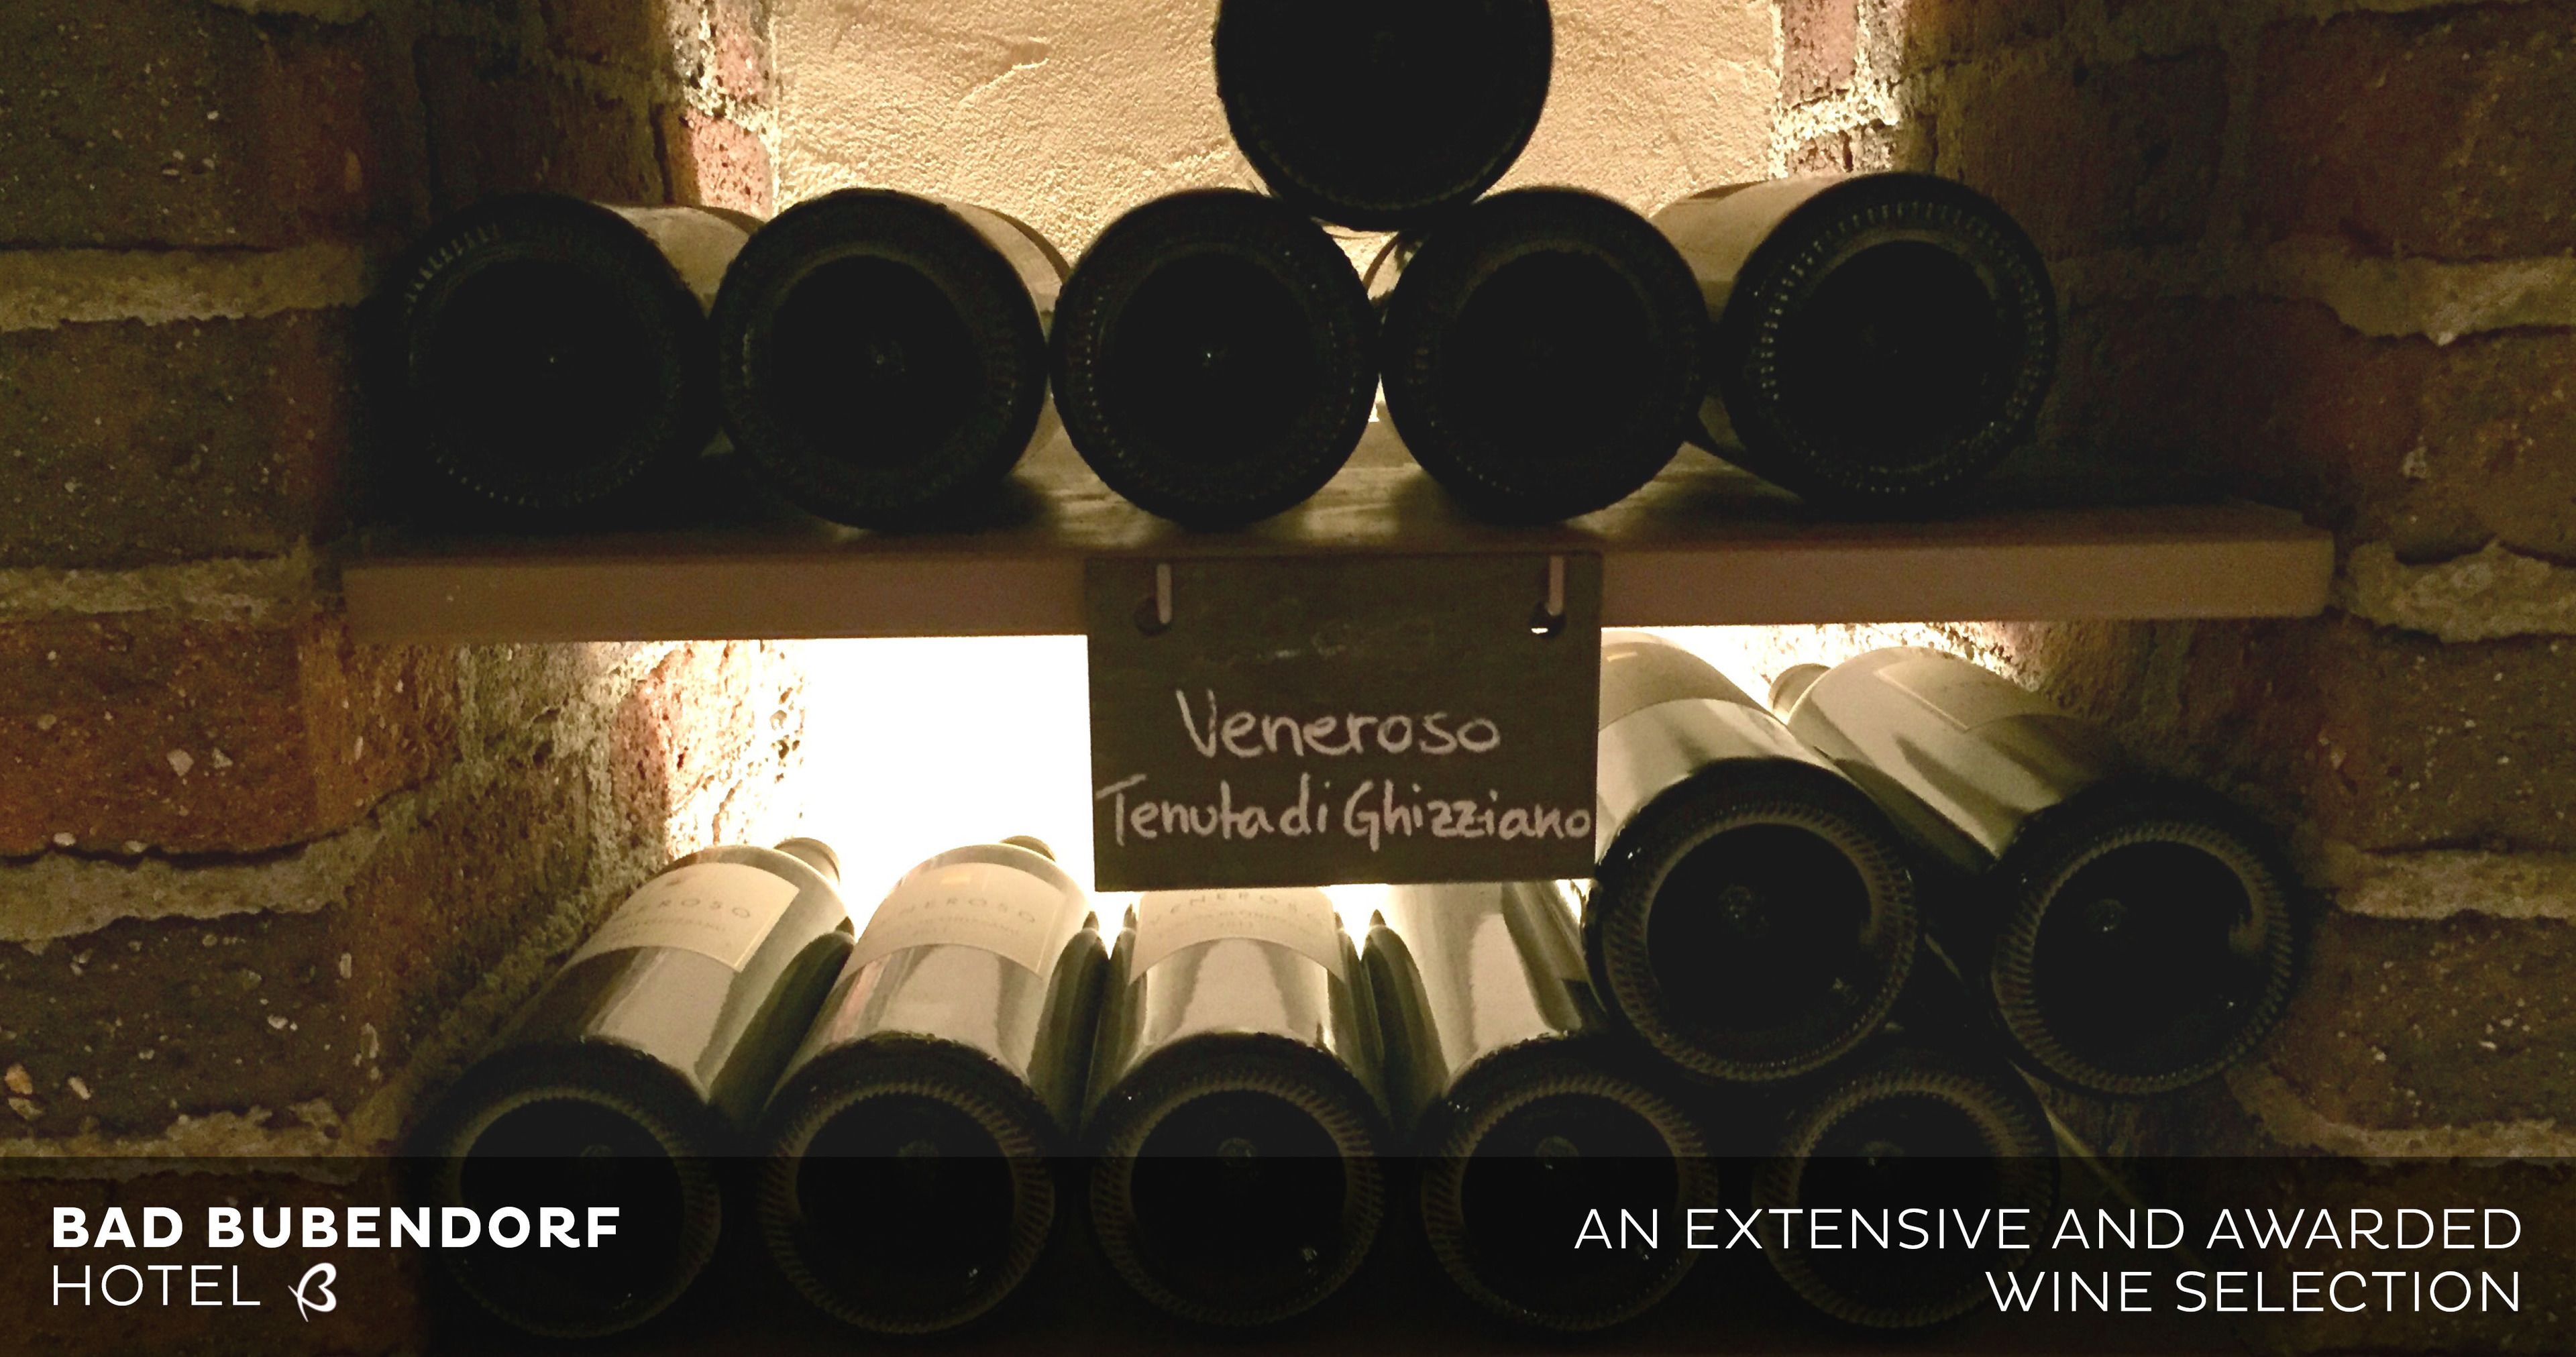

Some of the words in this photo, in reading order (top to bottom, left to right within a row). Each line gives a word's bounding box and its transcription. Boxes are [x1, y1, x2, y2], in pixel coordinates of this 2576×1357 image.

[1175, 689, 1501, 757] Veneroso
[1095, 773, 1275, 847] Tenuta
[1279, 771, 1330, 836] di
[1344, 779, 1591, 853] Ghizziano
